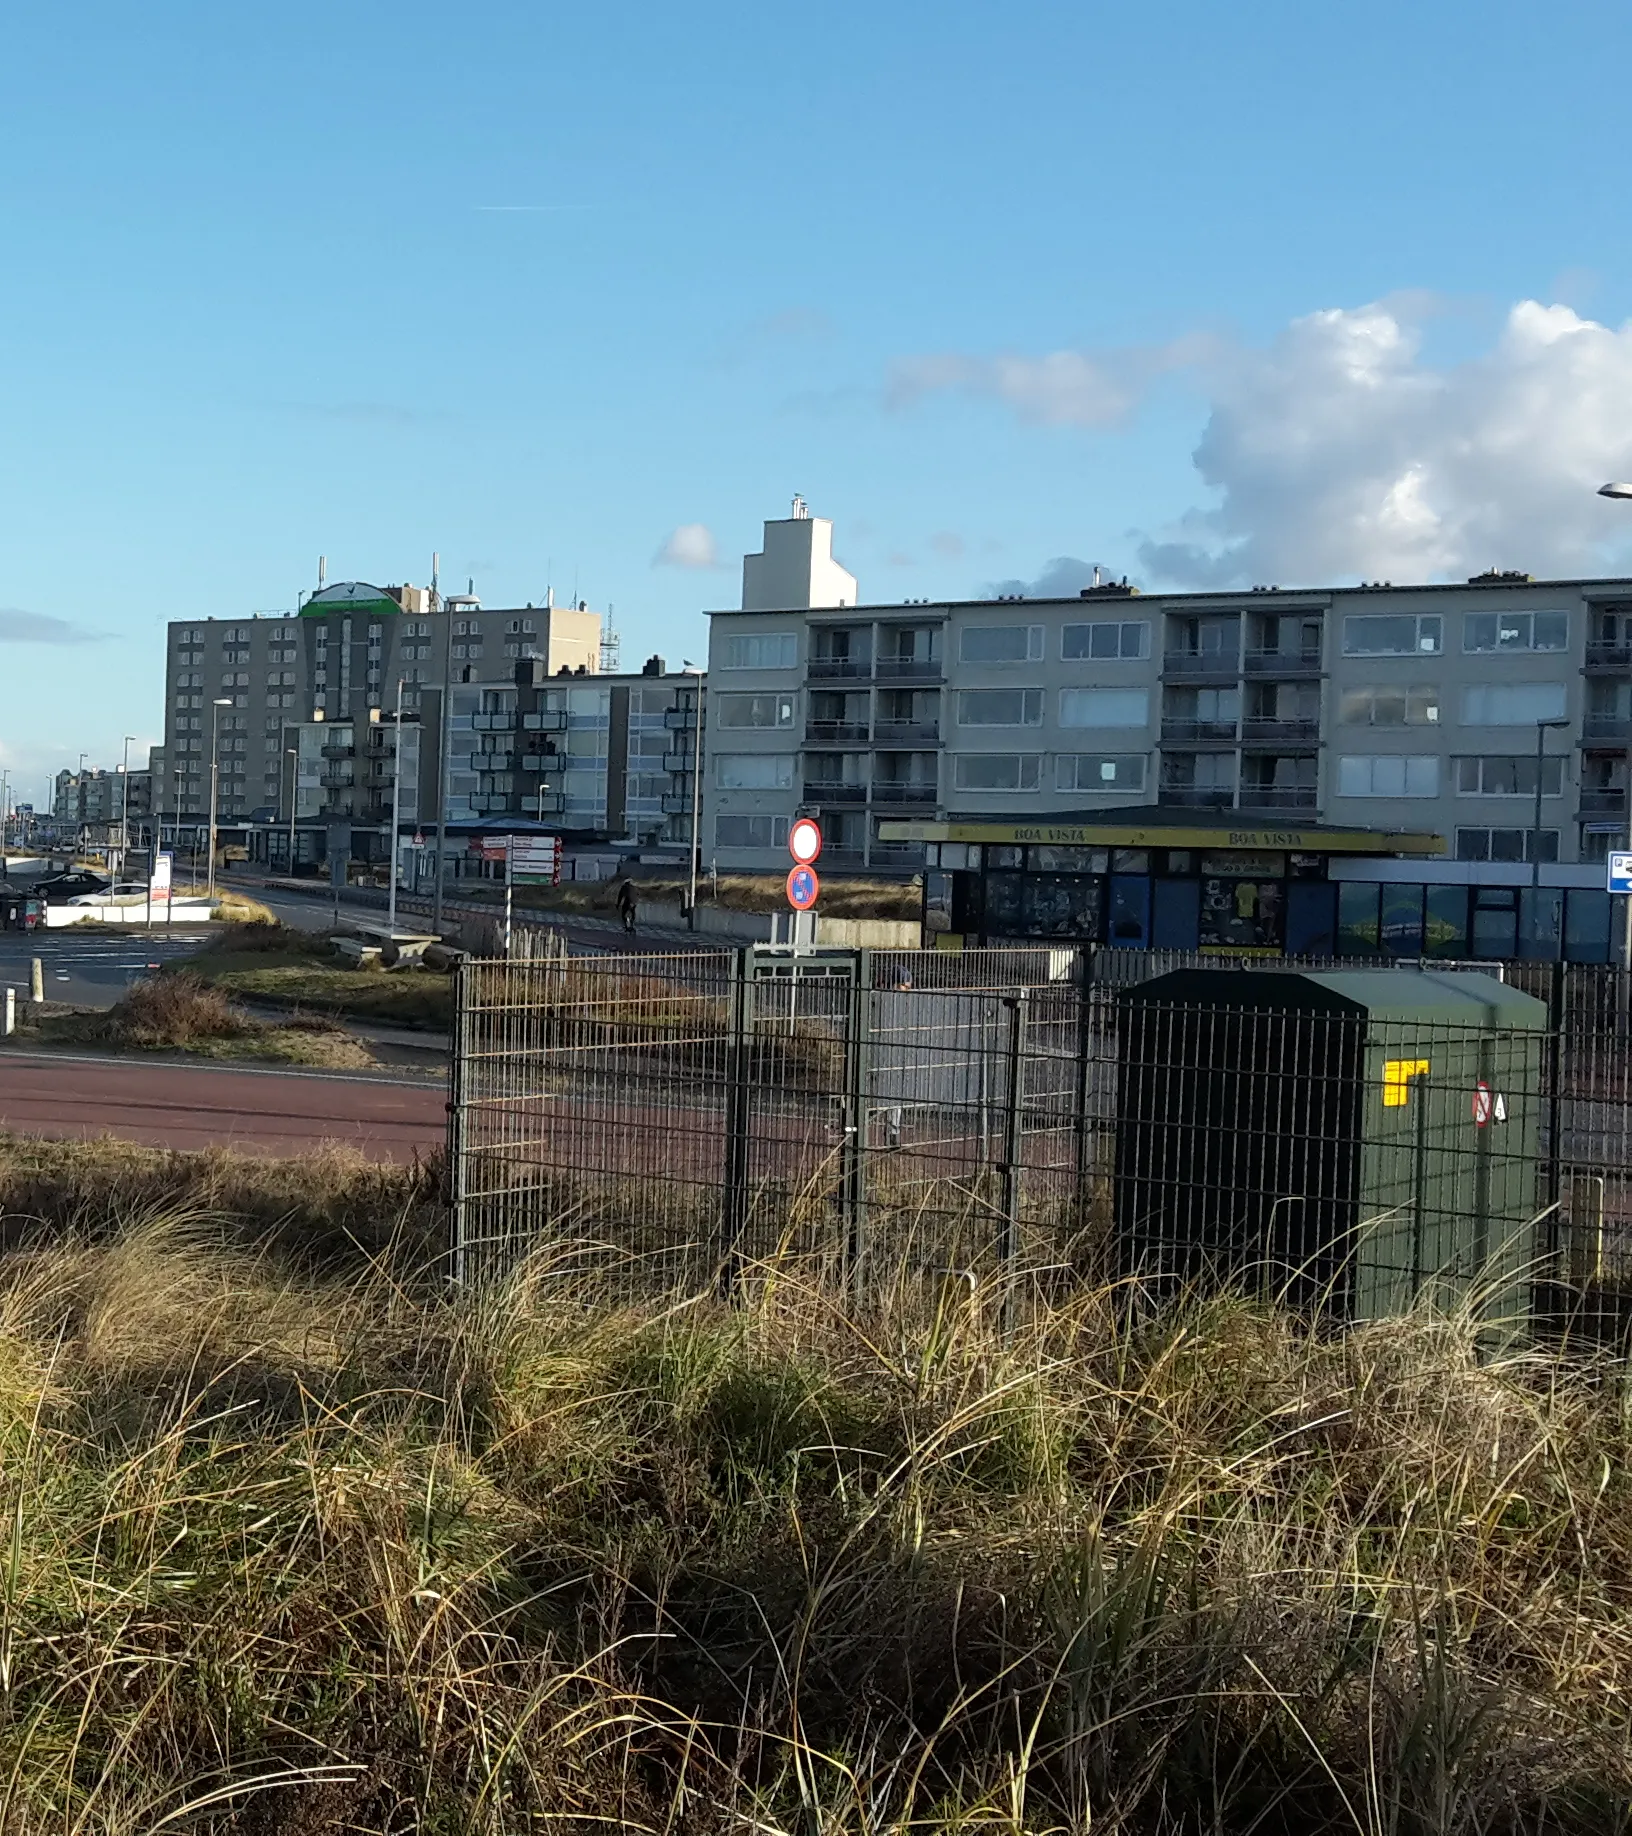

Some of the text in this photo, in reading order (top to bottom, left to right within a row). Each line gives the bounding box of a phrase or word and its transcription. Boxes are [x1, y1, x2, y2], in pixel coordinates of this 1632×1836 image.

[1014, 828, 1086, 841] BOA VISTA
[1229, 832, 1257, 845] BOA
